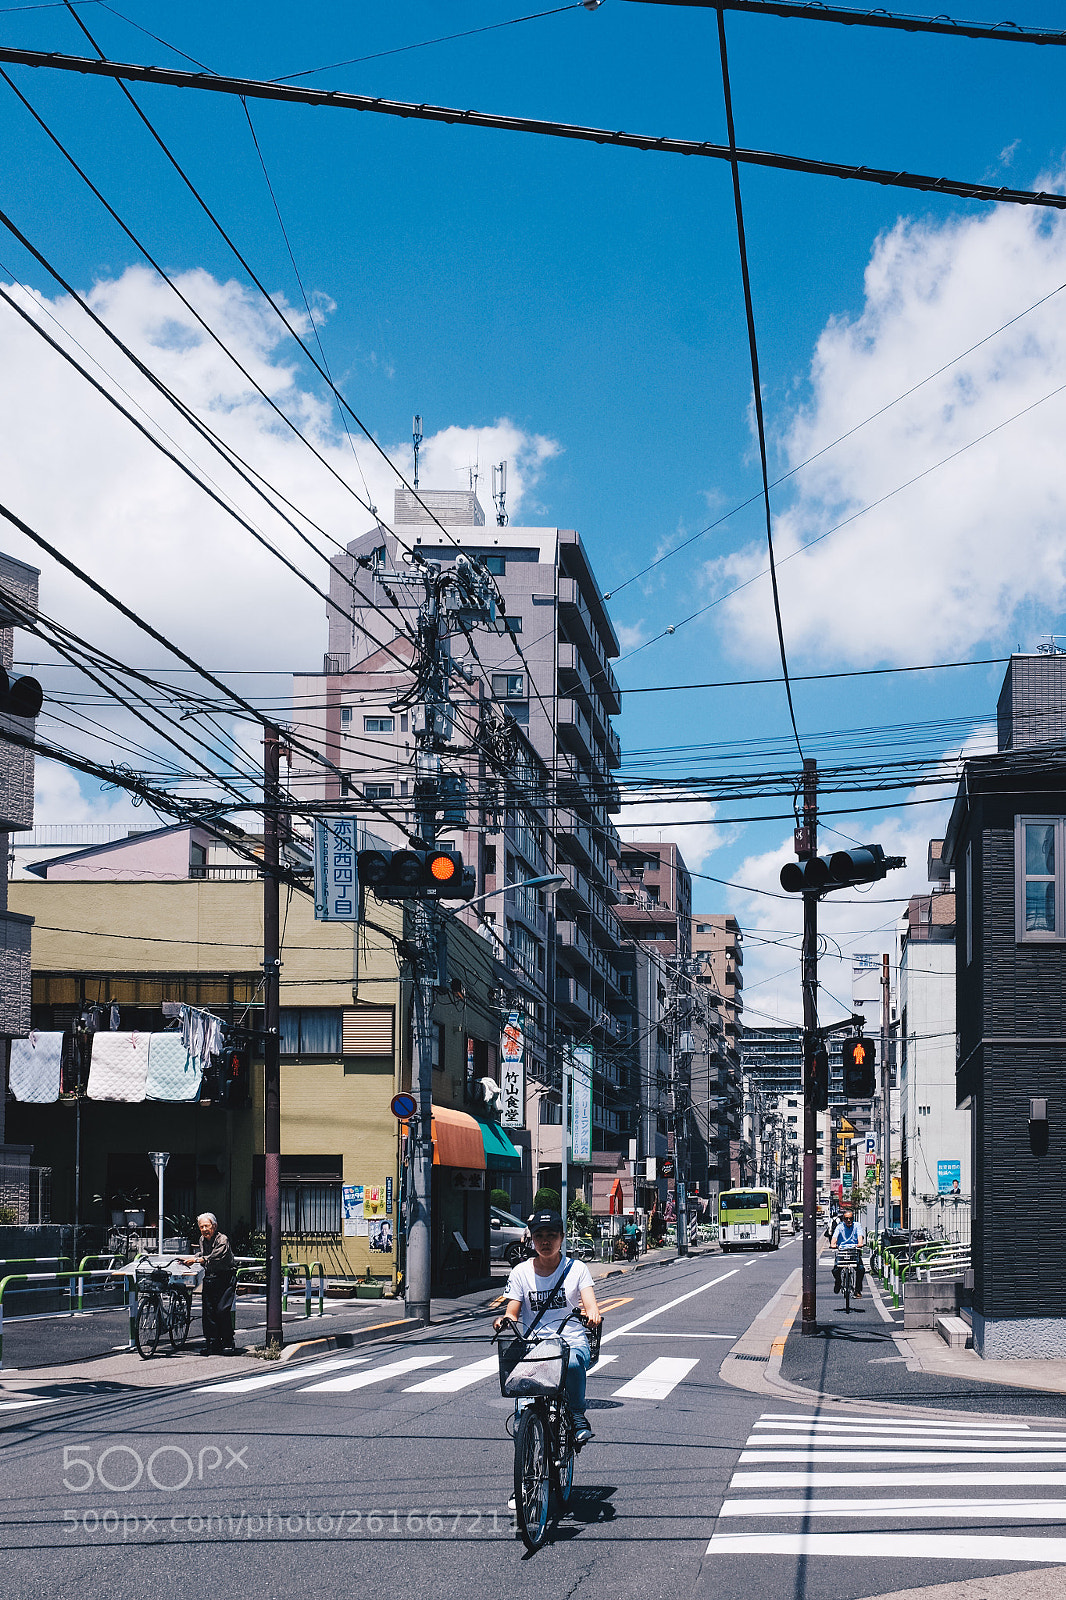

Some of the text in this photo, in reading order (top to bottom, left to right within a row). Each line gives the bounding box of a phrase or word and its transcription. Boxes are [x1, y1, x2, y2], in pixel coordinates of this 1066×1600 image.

[333, 820, 353, 915] 赤羽西四丁目
[504, 1071, 520, 1122] 竹山食堂
[866, 1139, 875, 1153] P
